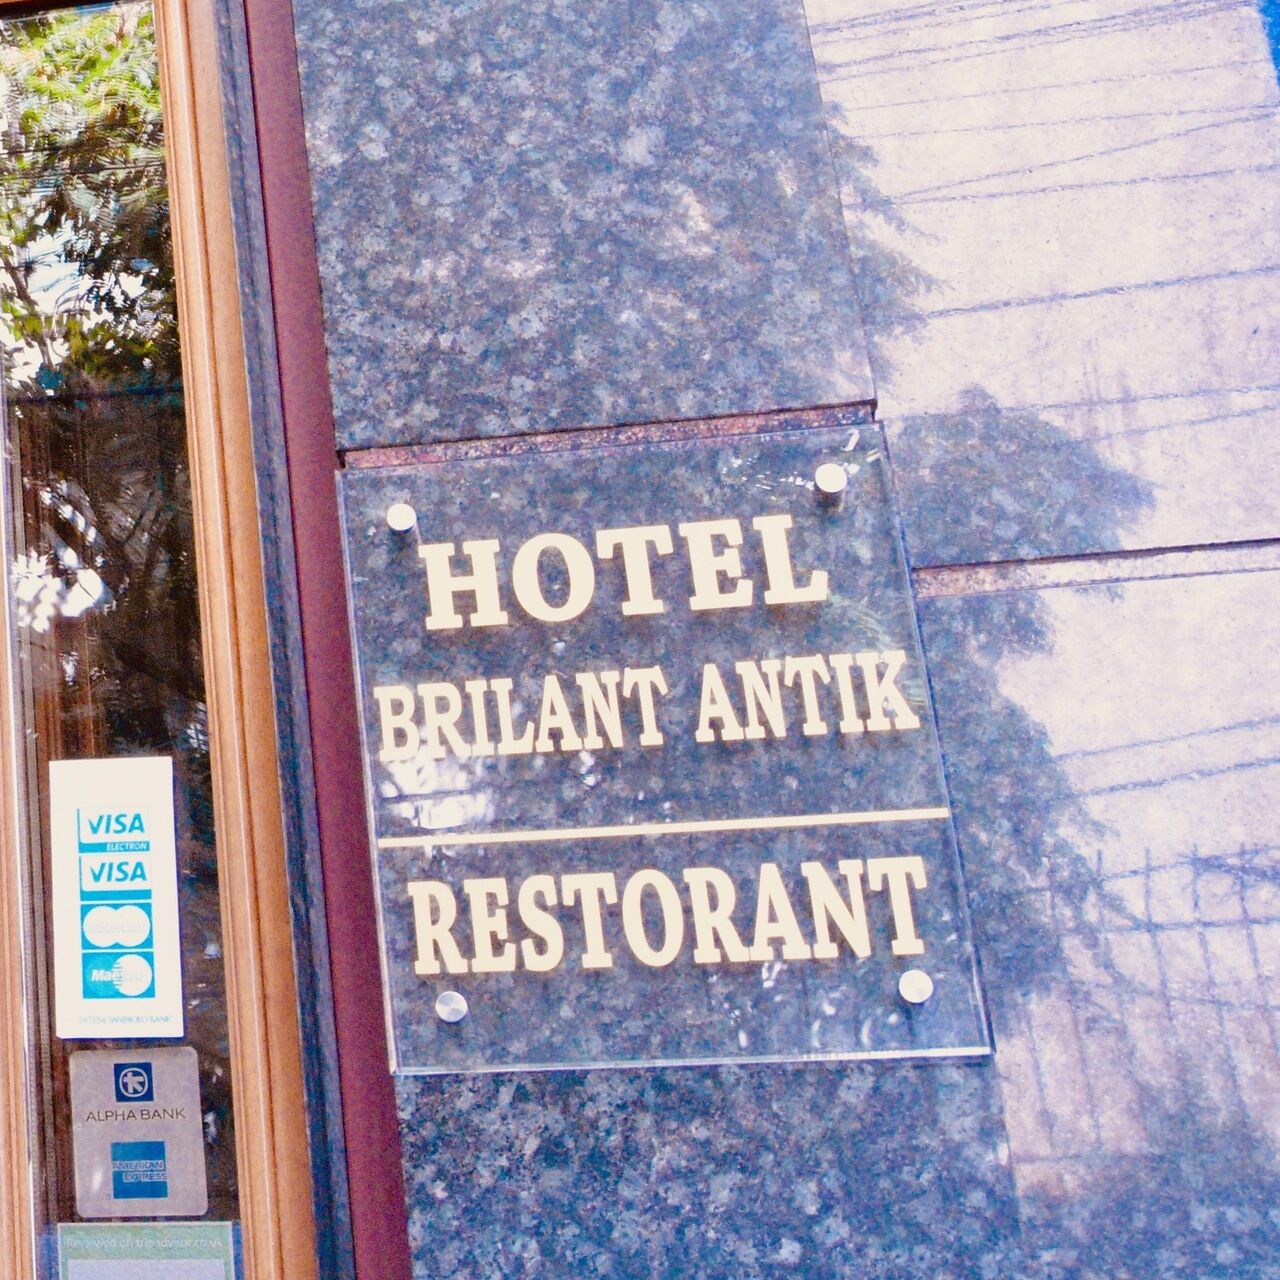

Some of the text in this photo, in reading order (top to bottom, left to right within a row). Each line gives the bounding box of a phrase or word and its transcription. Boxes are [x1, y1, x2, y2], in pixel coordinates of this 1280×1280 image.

[418, 514, 829, 631] HOTEL
[374, 650, 921, 763] BRILANT ANTIK
[89, 813, 145, 834] VISA
[106, 841, 148, 852] ELECTRON
[90, 861, 147, 882] VISA
[407, 855, 928, 976] RESTORANT
[86, 1108, 186, 1122] ALPHA BANK
[123, 1171, 168, 1182] EXPRESS
